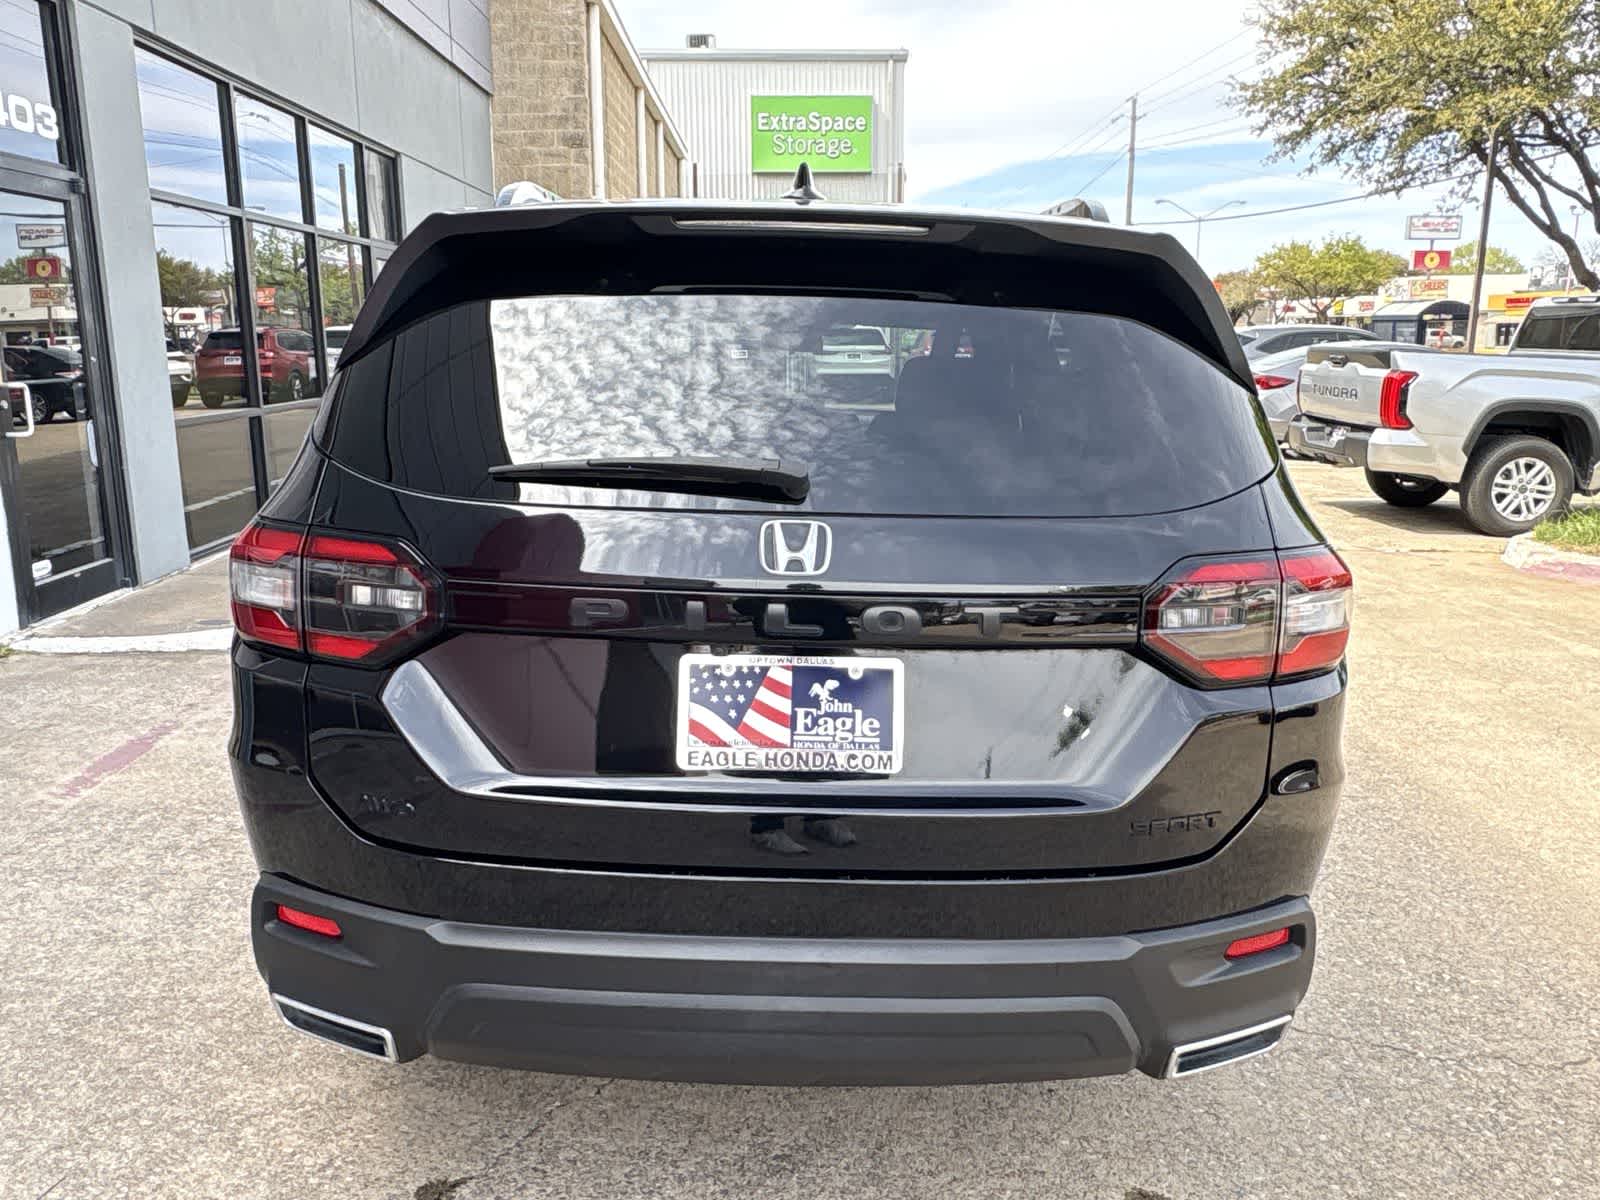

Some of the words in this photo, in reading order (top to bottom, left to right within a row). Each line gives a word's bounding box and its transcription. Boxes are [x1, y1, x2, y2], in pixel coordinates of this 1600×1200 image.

[773, 135, 852, 158] Storage
[1313, 384, 1359, 401] TUNDRA
[568, 598, 1020, 639] PILOT
[749, 656, 793, 665] UPTOWN
[796, 657, 835, 666] DALLAS
[819, 698, 853, 716] John
[793, 707, 881, 743] Eagle
[793, 741, 824, 750] HONDA
[826, 742, 838, 750] OF
[840, 742, 880, 751] DALLAS
[687, 750, 758, 767] EAGLE
